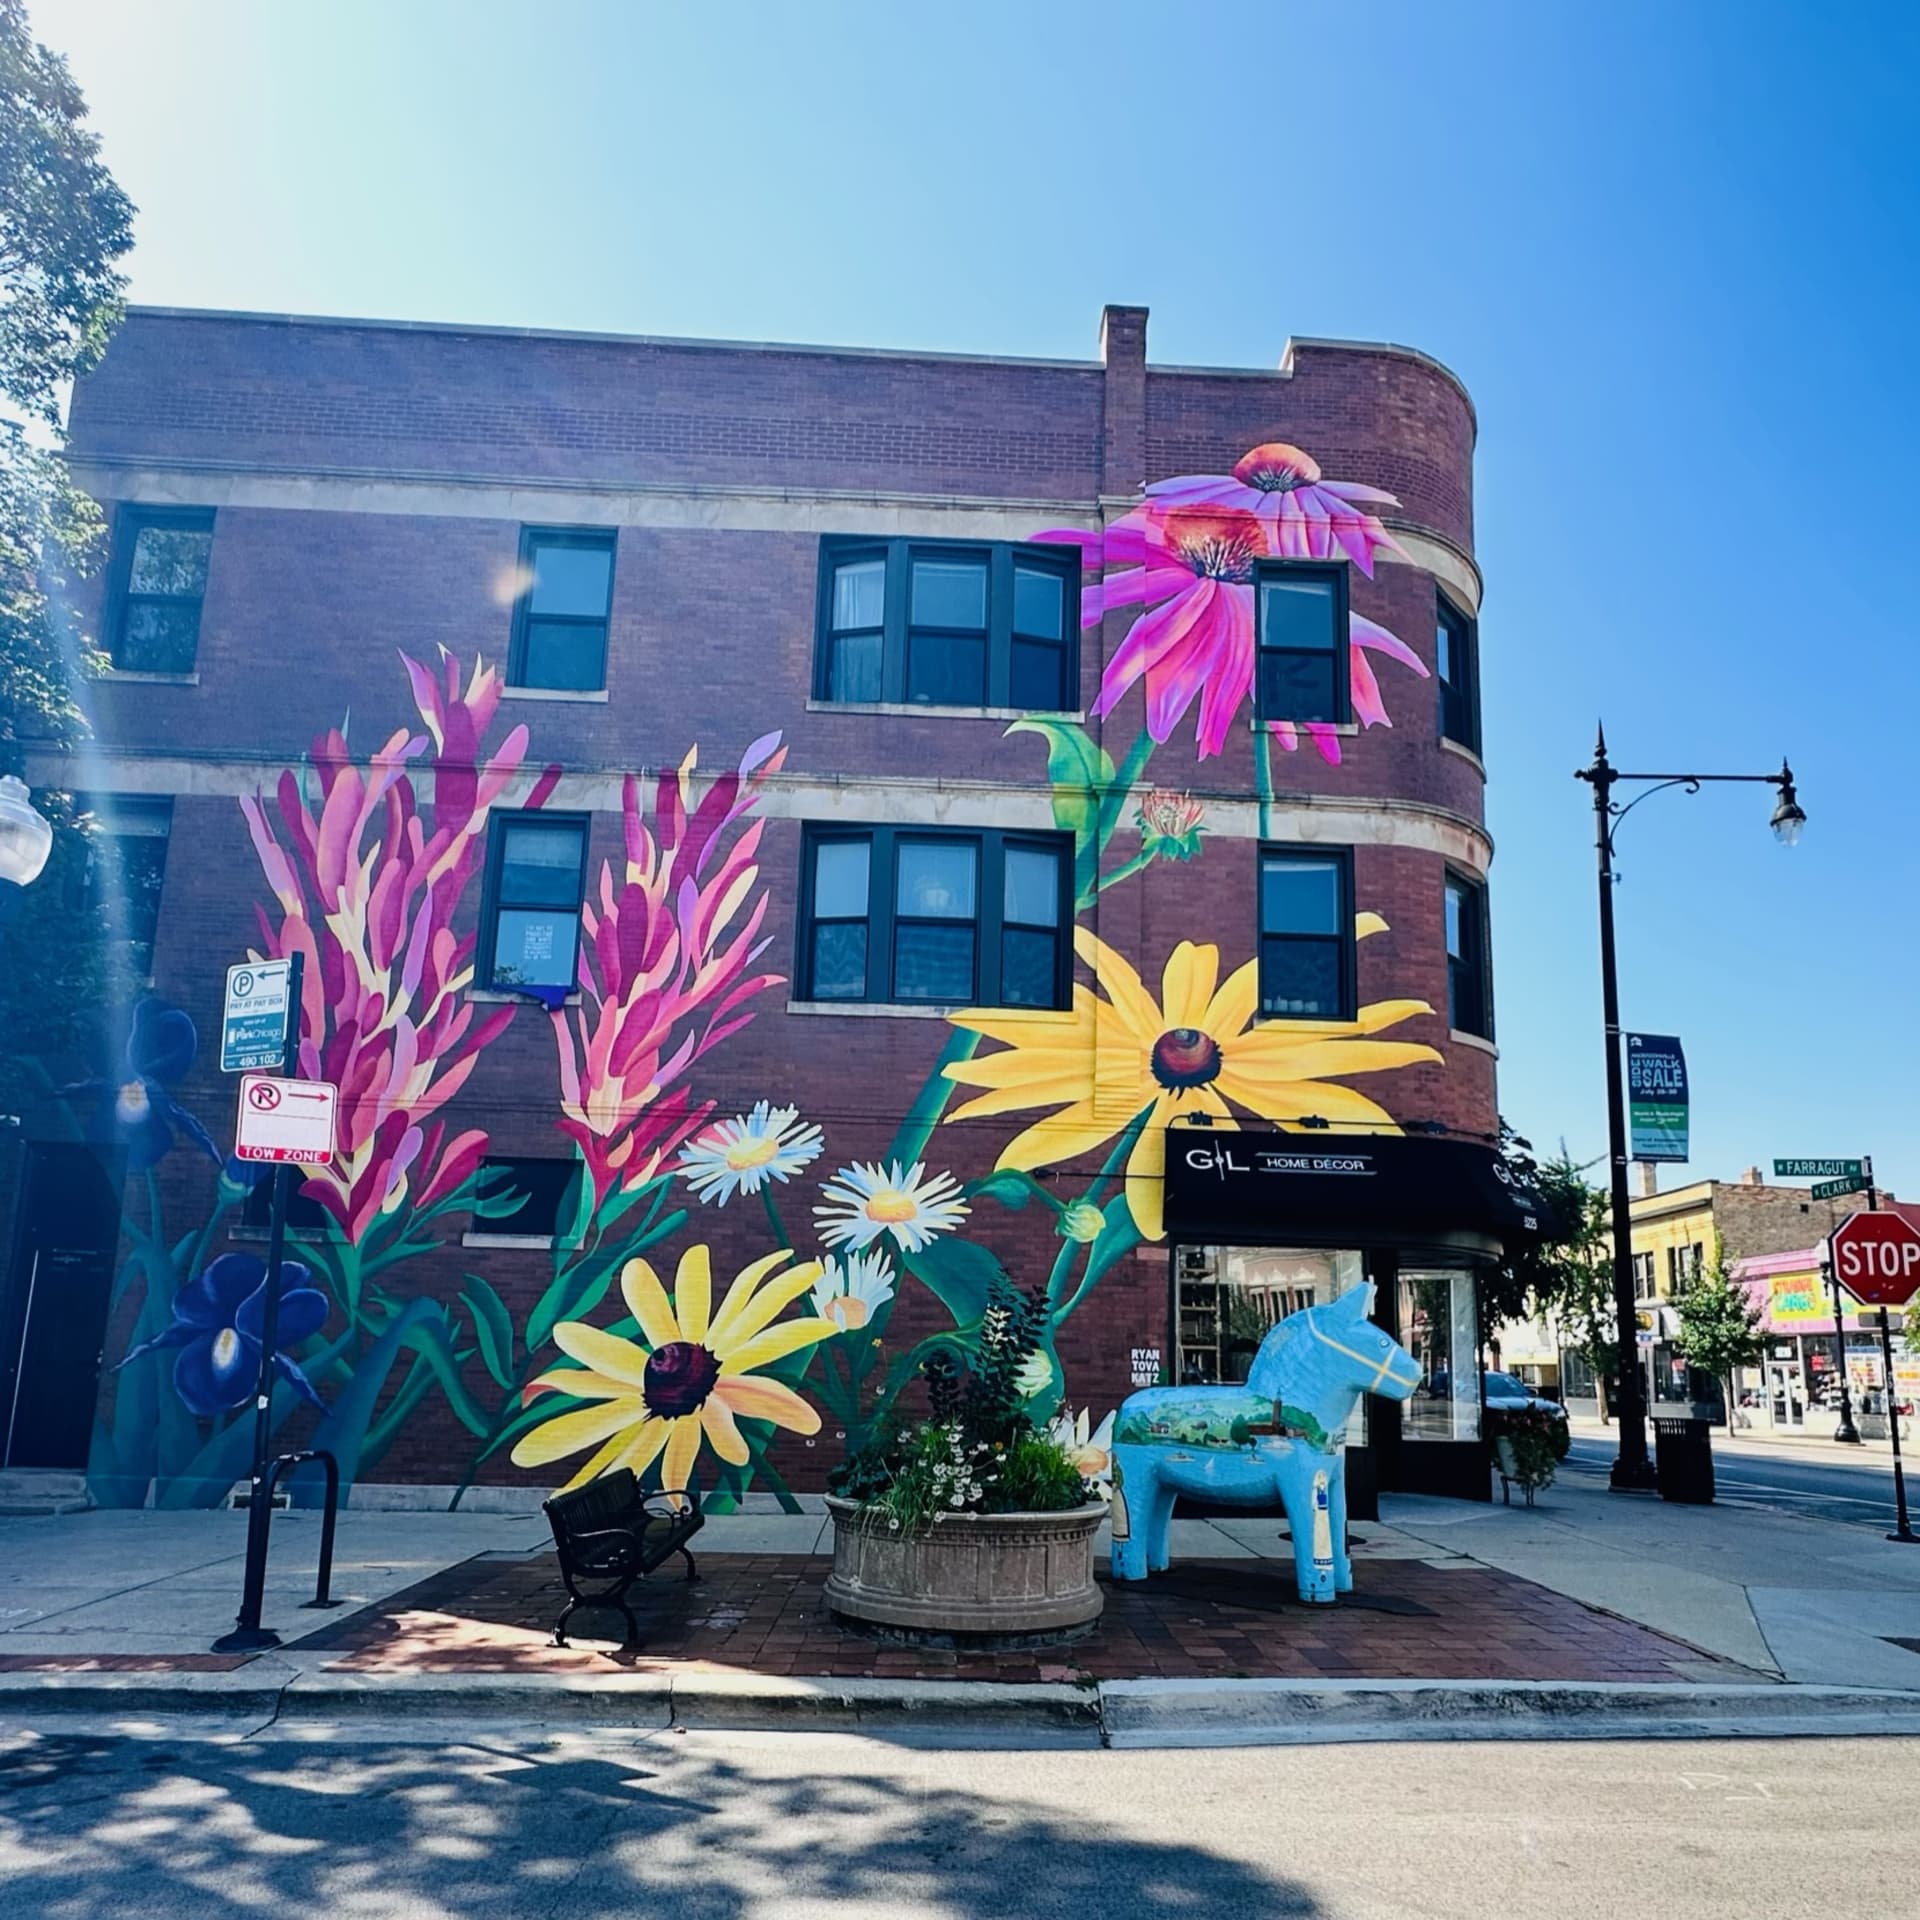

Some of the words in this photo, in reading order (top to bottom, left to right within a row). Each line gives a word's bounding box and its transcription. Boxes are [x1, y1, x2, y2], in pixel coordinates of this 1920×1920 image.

[260, 1054, 276, 1064] 102
[1642, 1059, 1681, 1069] WALK
[1642, 1069, 1683, 1088] SALE
[244, 1147, 276, 1159] TOW
[283, 1150, 322, 1162] ZONE
[1266, 1158, 1310, 1168] HOME
[1786, 1161, 1846, 1175] FARRAGUT
[1820, 1178, 1853, 1198] CLARK
[1841, 1241, 1920, 1277] STOP
[1131, 1349, 1160, 1360] RYAN
[1132, 1360, 1160, 1371] TOVA
[1131, 1372, 1160, 1384] KATZ
